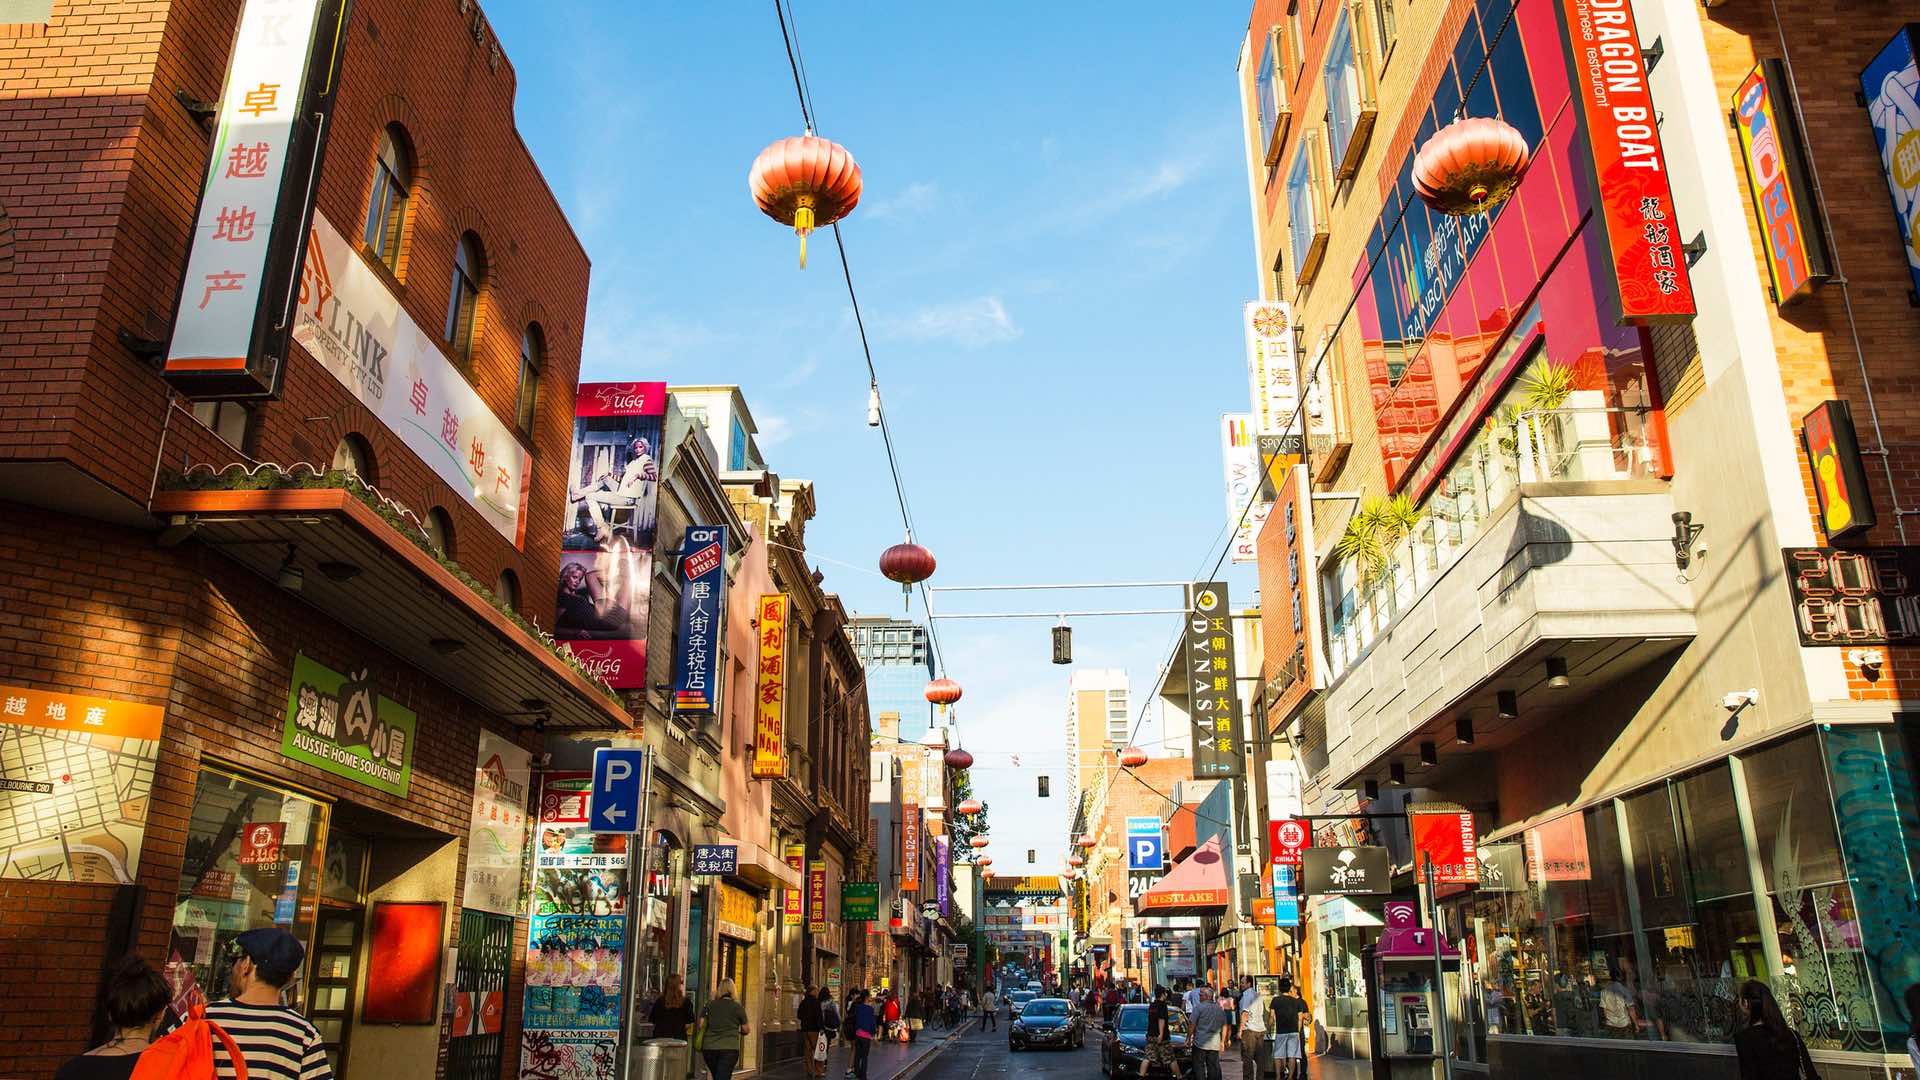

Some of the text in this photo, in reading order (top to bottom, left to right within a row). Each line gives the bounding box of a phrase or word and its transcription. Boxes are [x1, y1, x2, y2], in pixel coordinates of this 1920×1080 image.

[1585, 47, 1610, 107] restaurant
[1612, 106, 1659, 172] BOAT
[198, 83, 280, 310] 卓越地产
[1640, 196, 1679, 295] 龍舫酒家
[303, 312, 383, 400] PROPERTY PTY LTD
[614, 395, 645, 408] UGG
[410, 378, 511, 494] 卓越地产
[1261, 438, 1300, 448] SPORTS
[690, 546, 717, 566] DUTY
[691, 558, 718, 576] FREE
[686, 581, 711, 689] 唐人街免税店
[1192, 619, 1214, 751] DYNASTY
[759, 708, 780, 736] LING
[292, 732, 401, 785] AUSSIE HOME SOUVENIR
[759, 733, 779, 757] NAN
[604, 759, 632, 792] P
[610, 857, 626, 866] $65
[696, 848, 734, 859] 唐人街
[1136, 840, 1155, 865] P
[1460, 814, 1478, 880] DRAGON BOAT
[696, 861, 733, 872] 免税店
[1150, 893, 1214, 903] WESTLAKE
